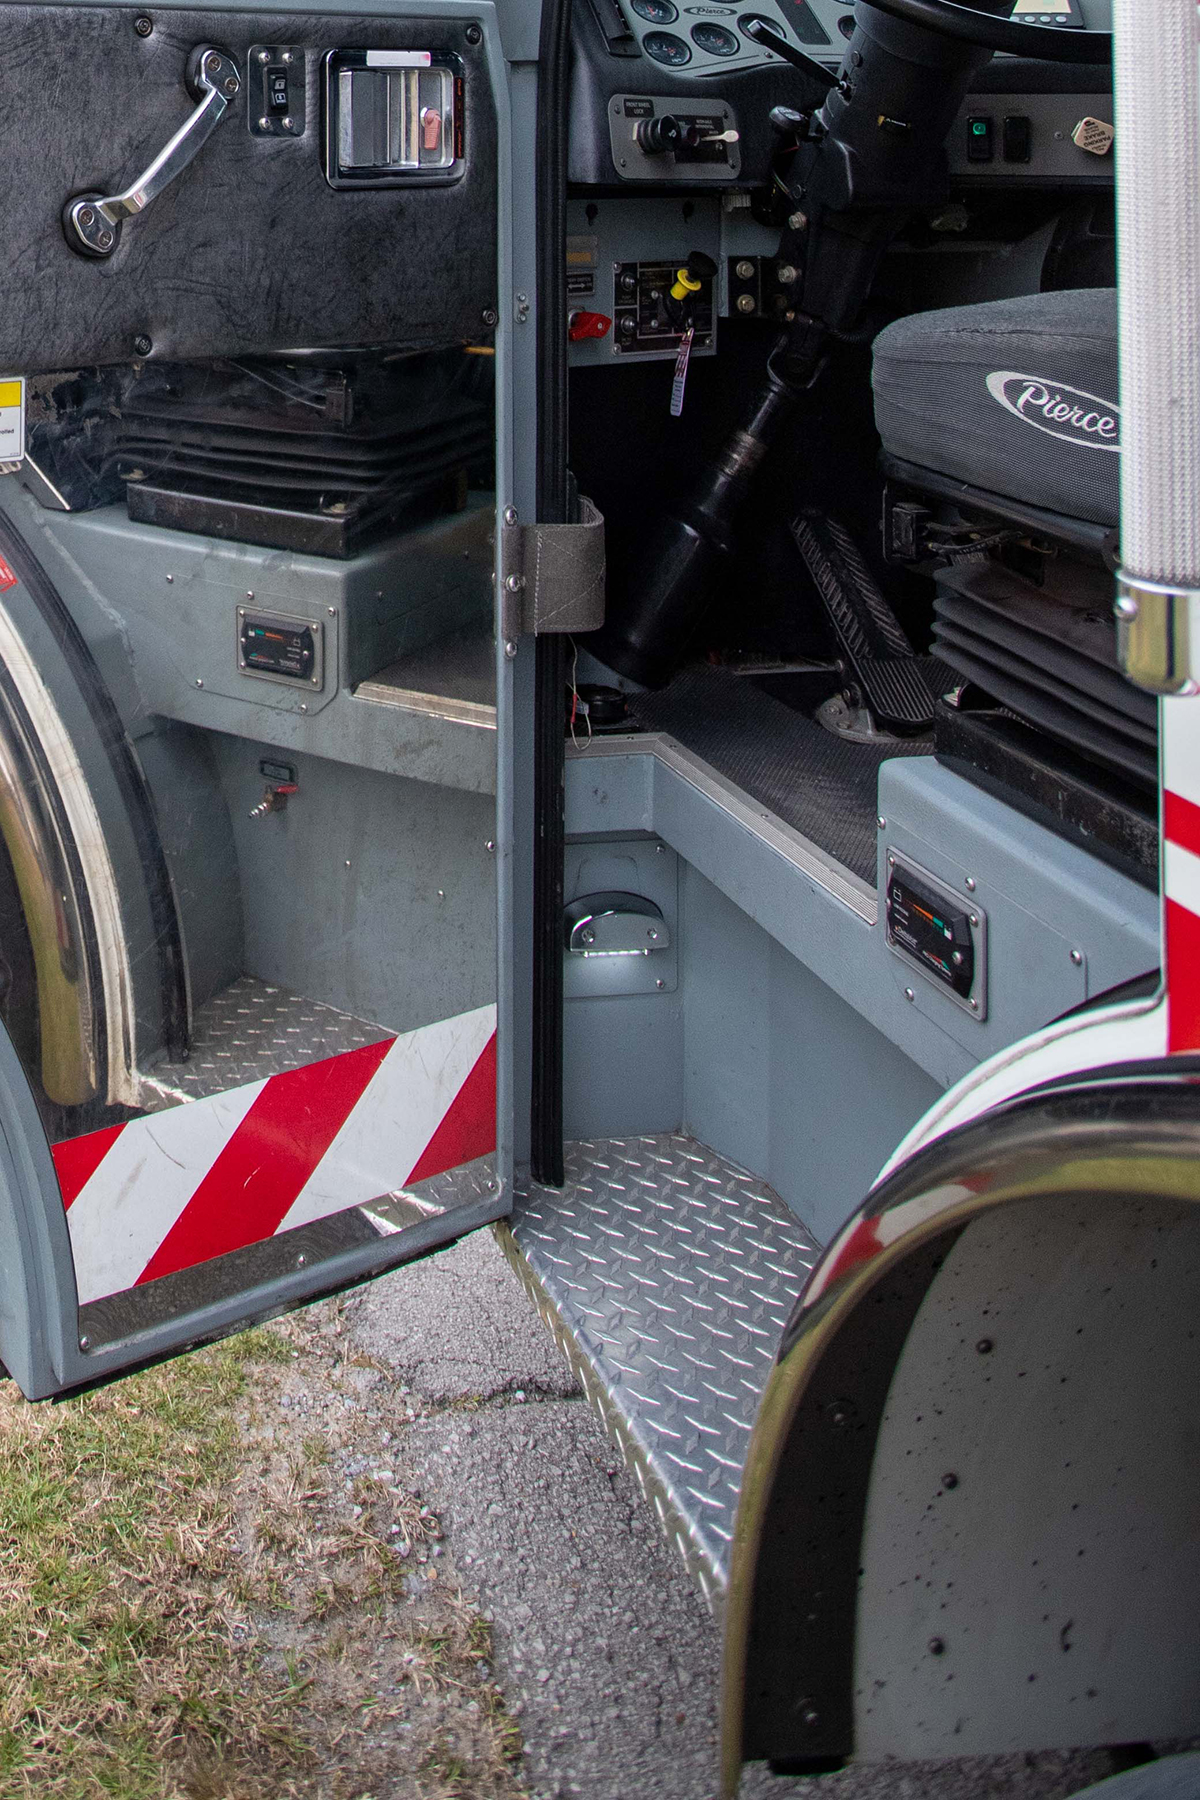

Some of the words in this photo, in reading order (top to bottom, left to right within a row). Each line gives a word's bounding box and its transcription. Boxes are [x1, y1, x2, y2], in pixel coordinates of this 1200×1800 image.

[1084, 131, 1105, 140] BRAKE
[1083, 136, 1110, 147] PARKING
[1017, 381, 1117, 437] Pierce
